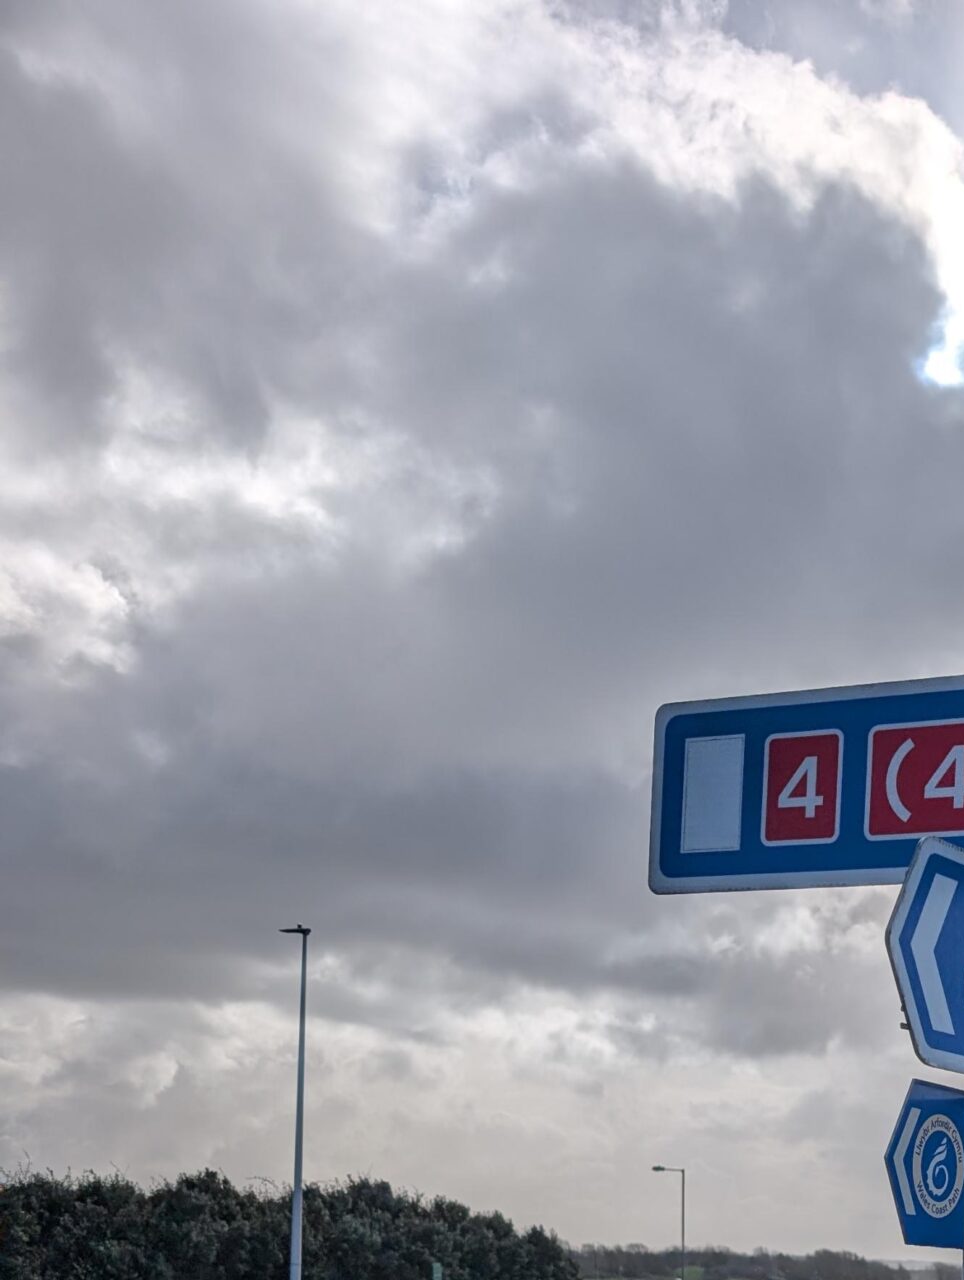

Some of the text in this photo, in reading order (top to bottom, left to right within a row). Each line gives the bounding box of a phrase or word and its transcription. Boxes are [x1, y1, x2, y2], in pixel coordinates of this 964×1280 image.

[777, 755, 824, 818] 4
[917, 1182, 960, 1215] Wales Coast Path
